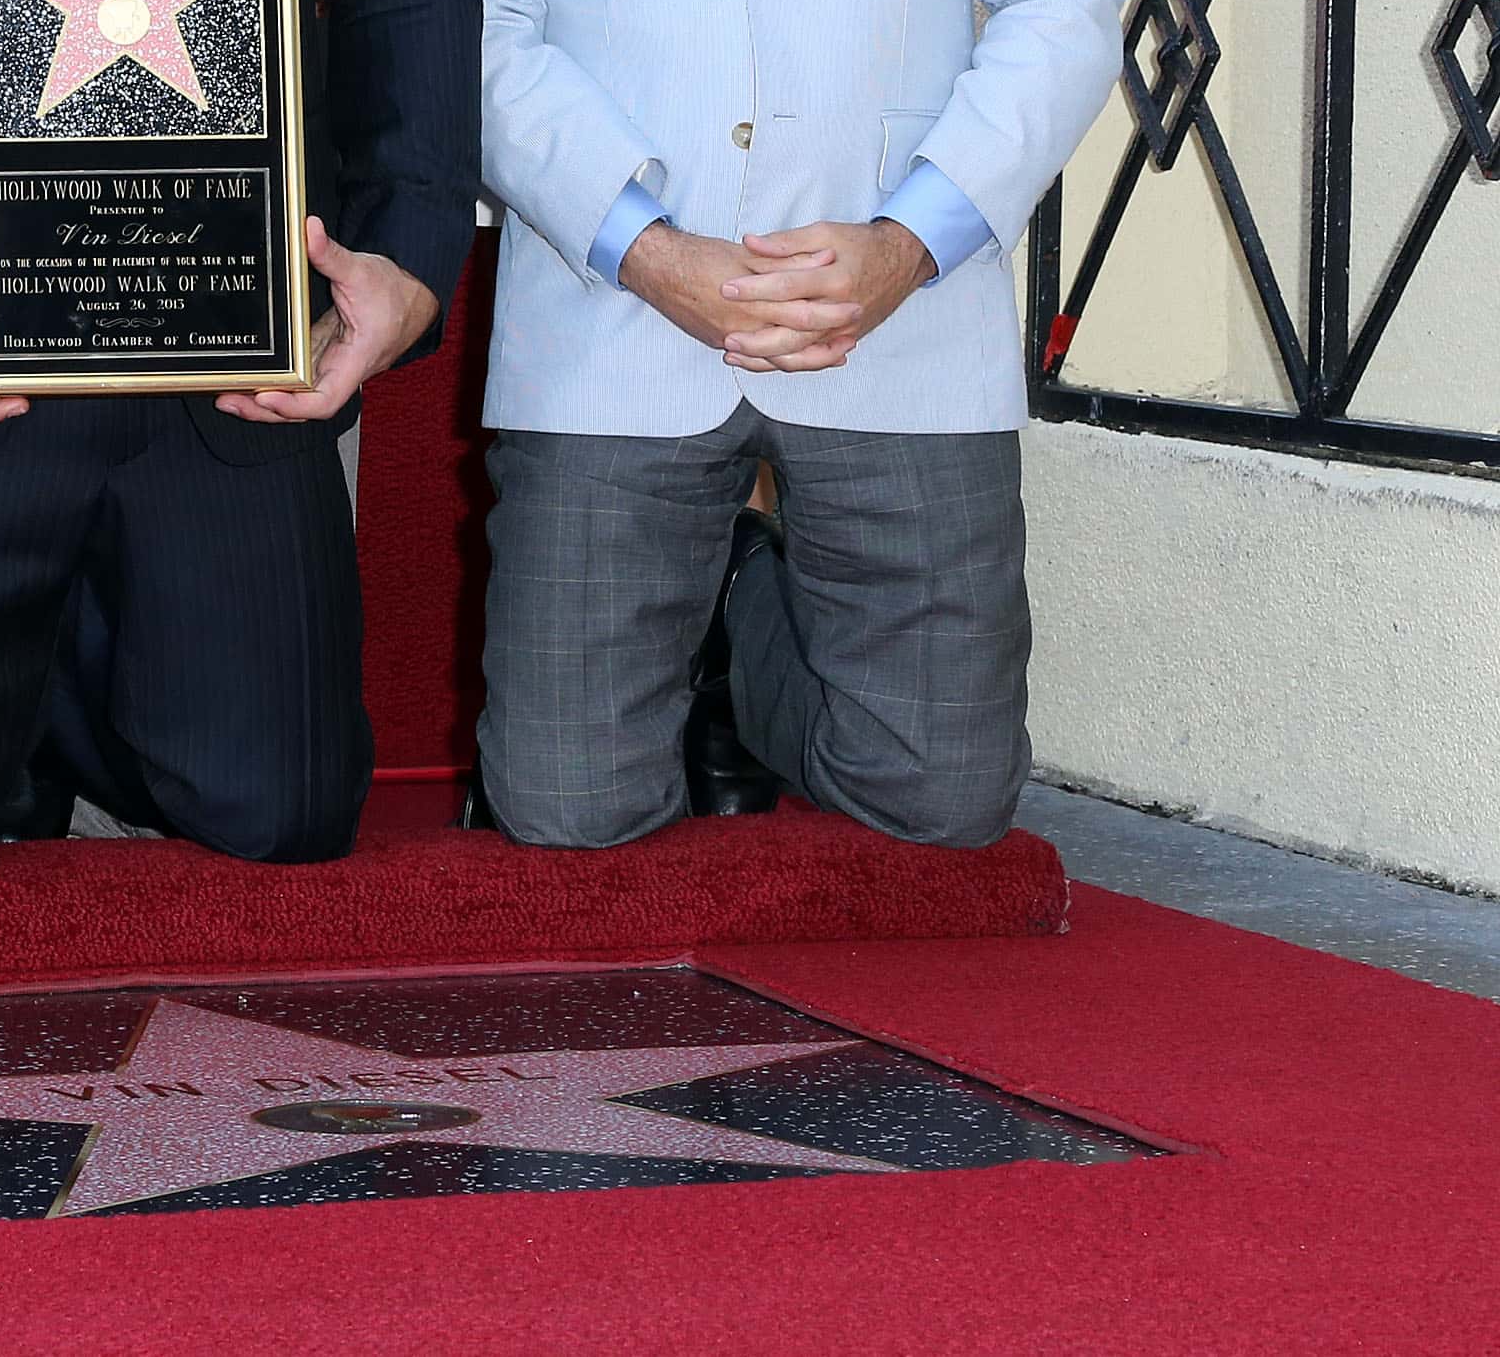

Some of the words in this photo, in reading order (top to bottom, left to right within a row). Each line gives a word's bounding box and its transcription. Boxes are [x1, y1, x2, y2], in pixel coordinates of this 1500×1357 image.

[113, 178, 163, 200] WALK
[173, 178, 195, 200] OF
[205, 177, 252, 199] FAME
[56, 223, 109, 246] Vin
[116, 222, 204, 245] Diesel
[0, 258, 11, 269] ON
[16, 258, 32, 268] THE
[35, 258, 73, 268] OCCASION
[77, 257, 87, 267] OF
[92, 257, 107, 267] THE
[112, 256, 156, 267] PLACEMENT
[175, 256, 197, 267] YOUR
[201, 256, 222, 266] STAR
[227, 256, 237, 266] IN
[241, 255, 256, 266] THE
[2, 276, 106, 295] HOLLYWOOD
[117, 275, 167, 293] WALK
[178, 274, 199, 292] OF
[210, 274, 257, 292] FAME
[156, 298, 185, 311] 2013
[43, 1080, 204, 1101] VIN
[251, 1066, 557, 1092] DIESEL
